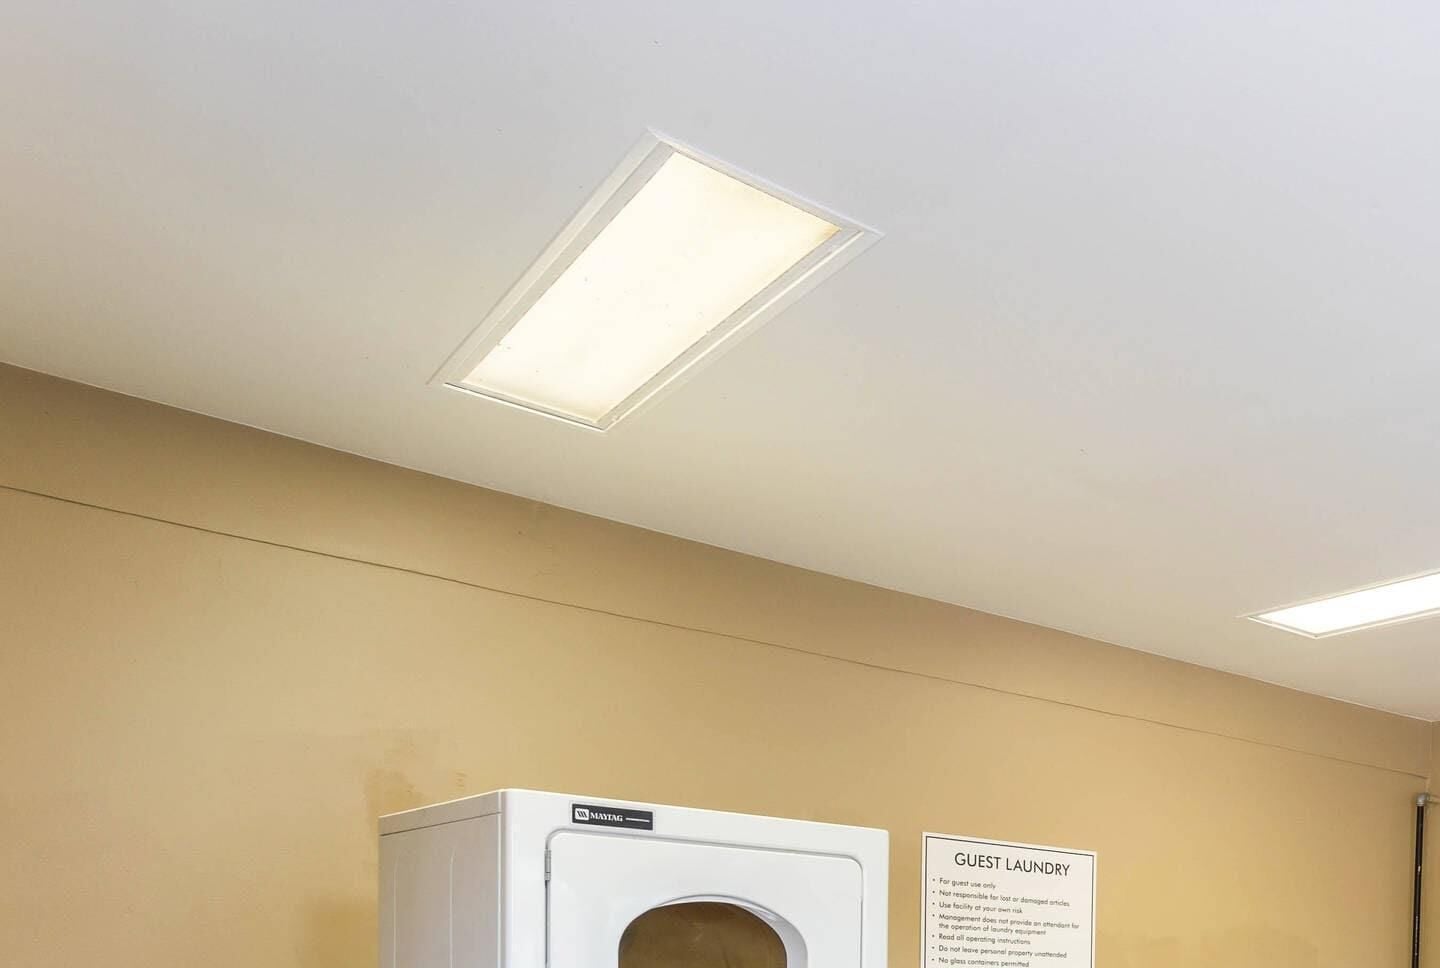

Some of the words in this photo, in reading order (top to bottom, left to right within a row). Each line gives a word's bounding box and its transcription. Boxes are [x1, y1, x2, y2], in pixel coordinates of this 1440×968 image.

[590, 812, 623, 822] MAYTAG
[954, 852, 1001, 870] GUEST
[1006, 858, 1070, 876] LAUNDRY
[939, 877, 950, 885] For
[951, 879, 969, 888] guest
[983, 882, 996, 890] only
[953, 891, 988, 901] responsible
[1020, 896, 1048, 906] damaged
[1049, 899, 1070, 907] articles
[939, 901, 951, 909] Use
[953, 902, 973, 912] facility
[939, 913, 981, 924] Management
[1010, 919, 1032, 928] provide
[1043, 920, 1070, 929] attendant
[951, 924, 981, 932] operation
[991, 925, 1013, 935] laundry
[1015, 928, 1046, 937] equipment
[966, 936, 996, 945] operating
[997, 937, 1031, 945] instructions
[962, 946, 978, 954] leave
[980, 947, 1006, 956] personal
[1008, 949, 1033, 958] property
[950, 958, 966, 966] glass
[968, 959, 999, 967] containers
[1001, 960, 1029, 968] permitted
